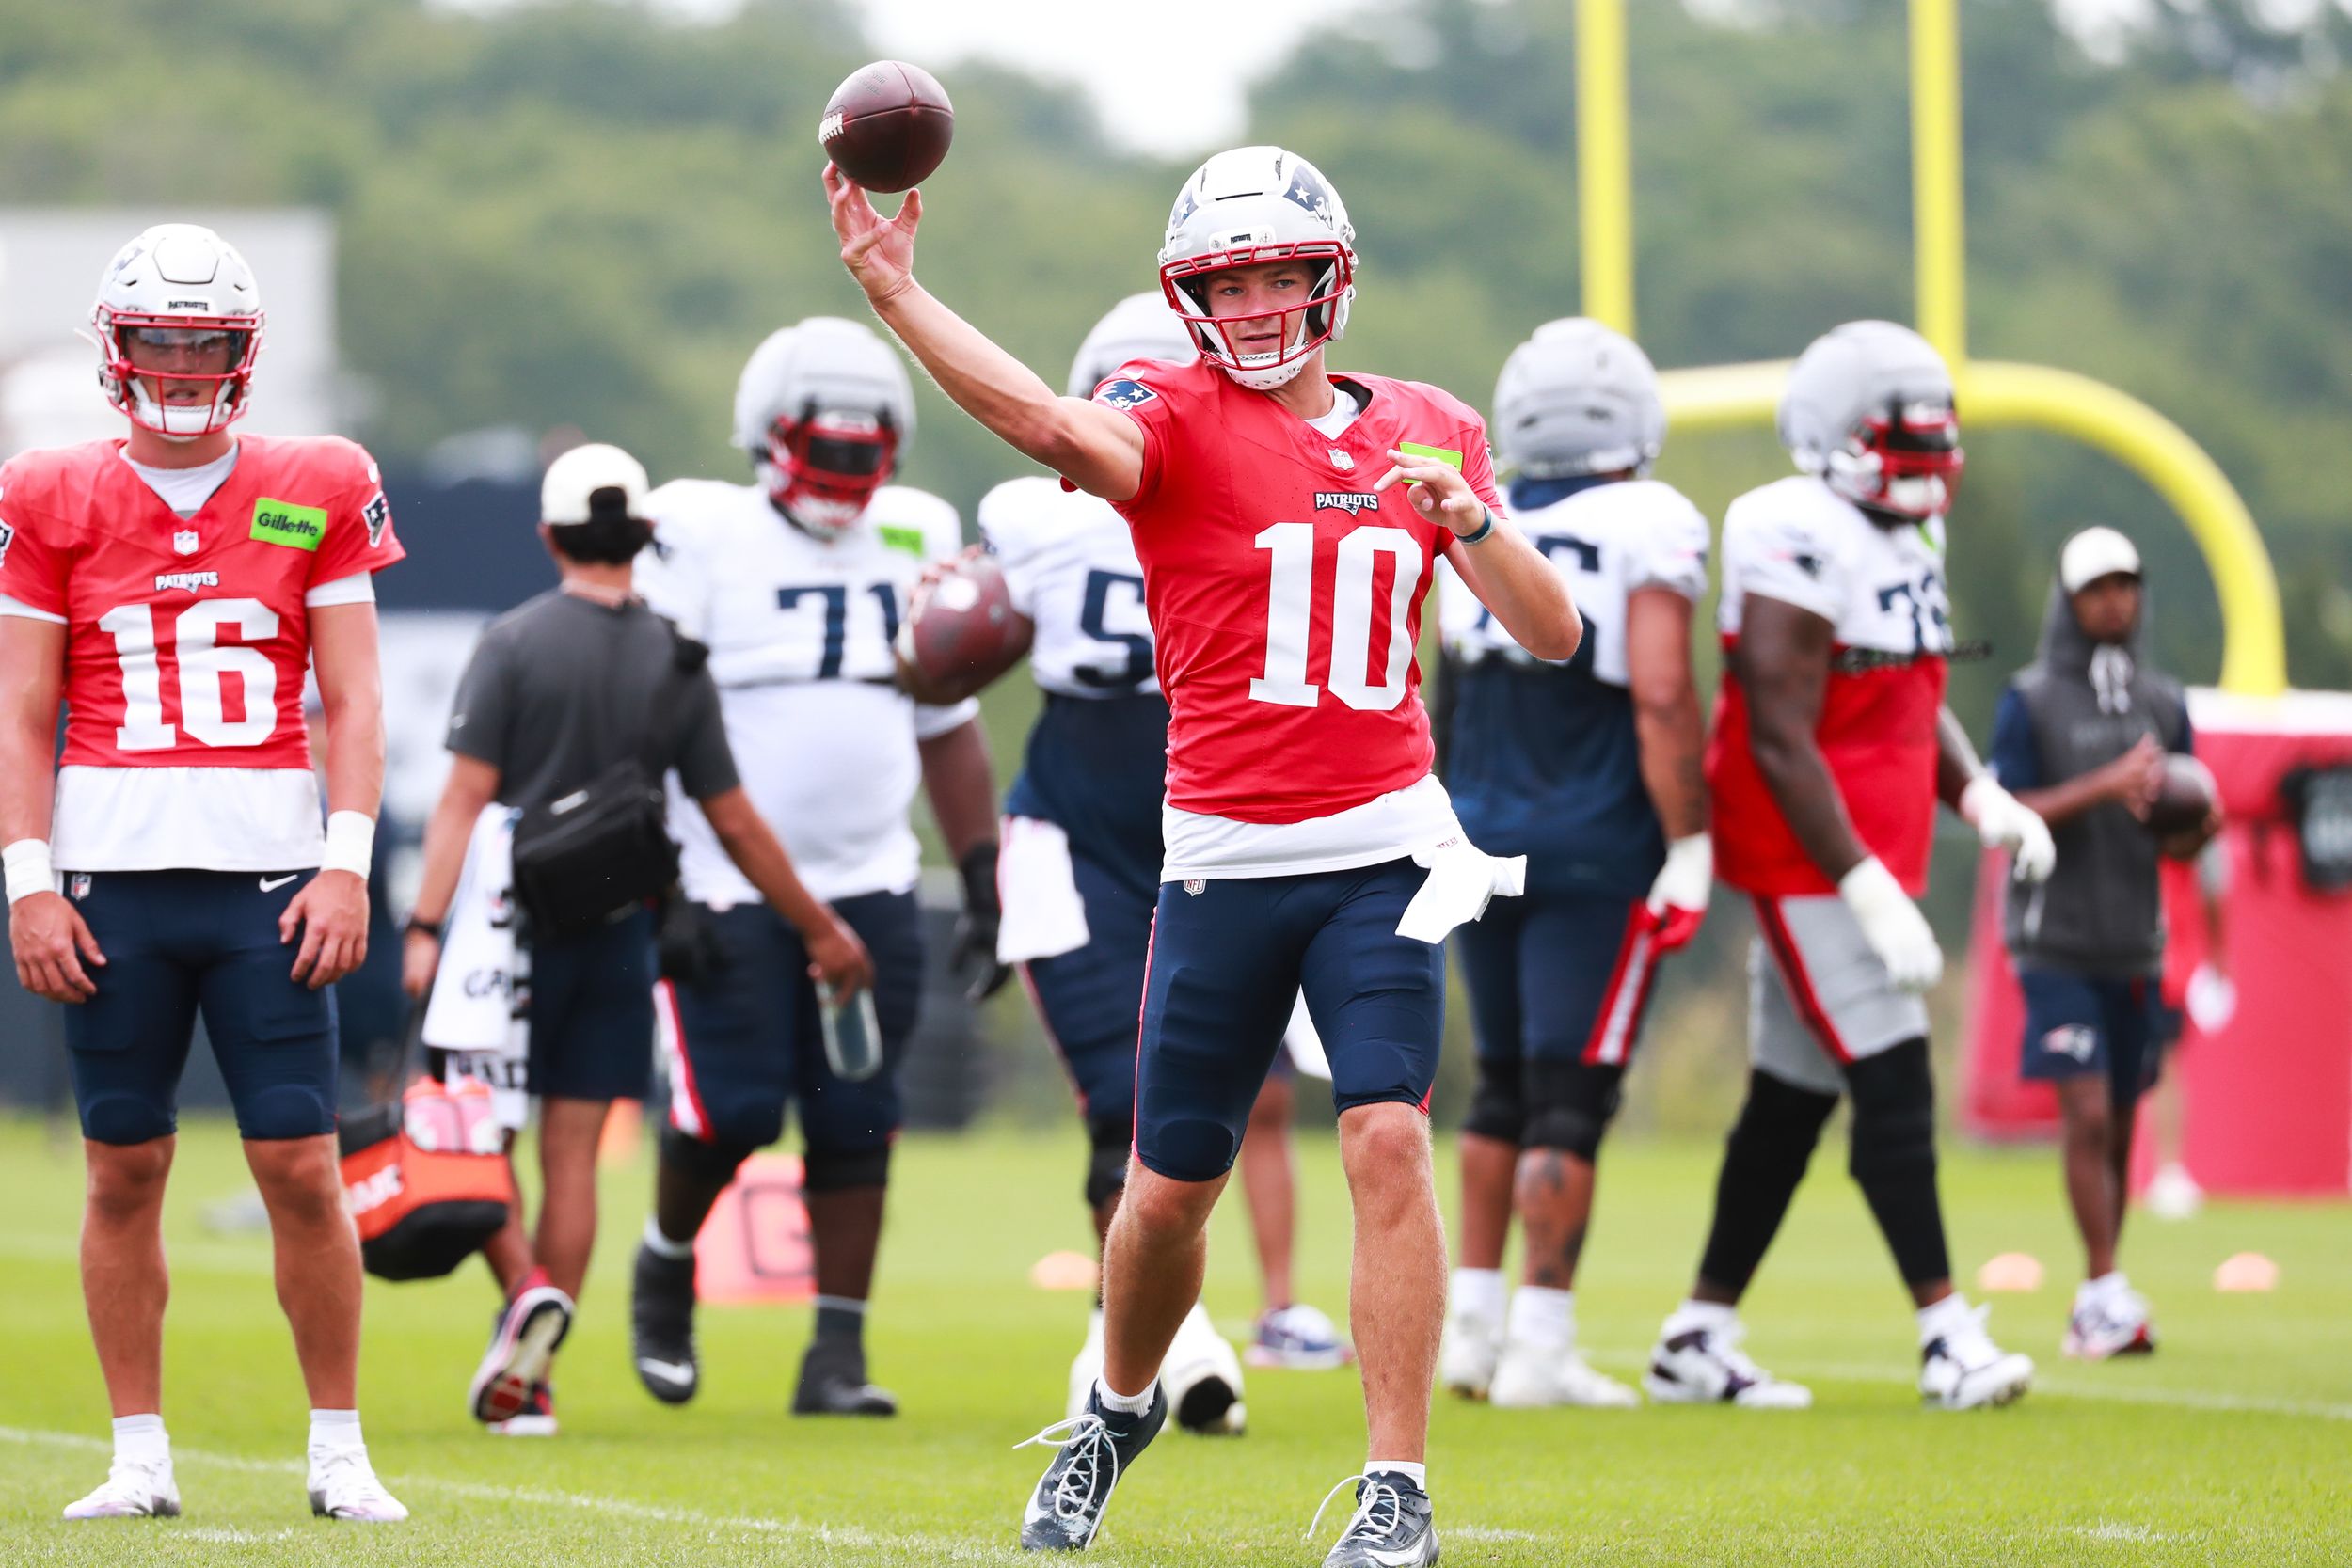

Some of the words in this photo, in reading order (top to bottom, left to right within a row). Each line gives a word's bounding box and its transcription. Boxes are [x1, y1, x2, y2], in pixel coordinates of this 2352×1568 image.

[258, 513, 318, 536] Gillette
[1315, 493, 1378, 510] PATRIOTS
[155, 571, 218, 591] PATRIOTS
[777, 582, 900, 679] 71
[1248, 522, 1423, 710] 10
[97, 598, 279, 750] 16
